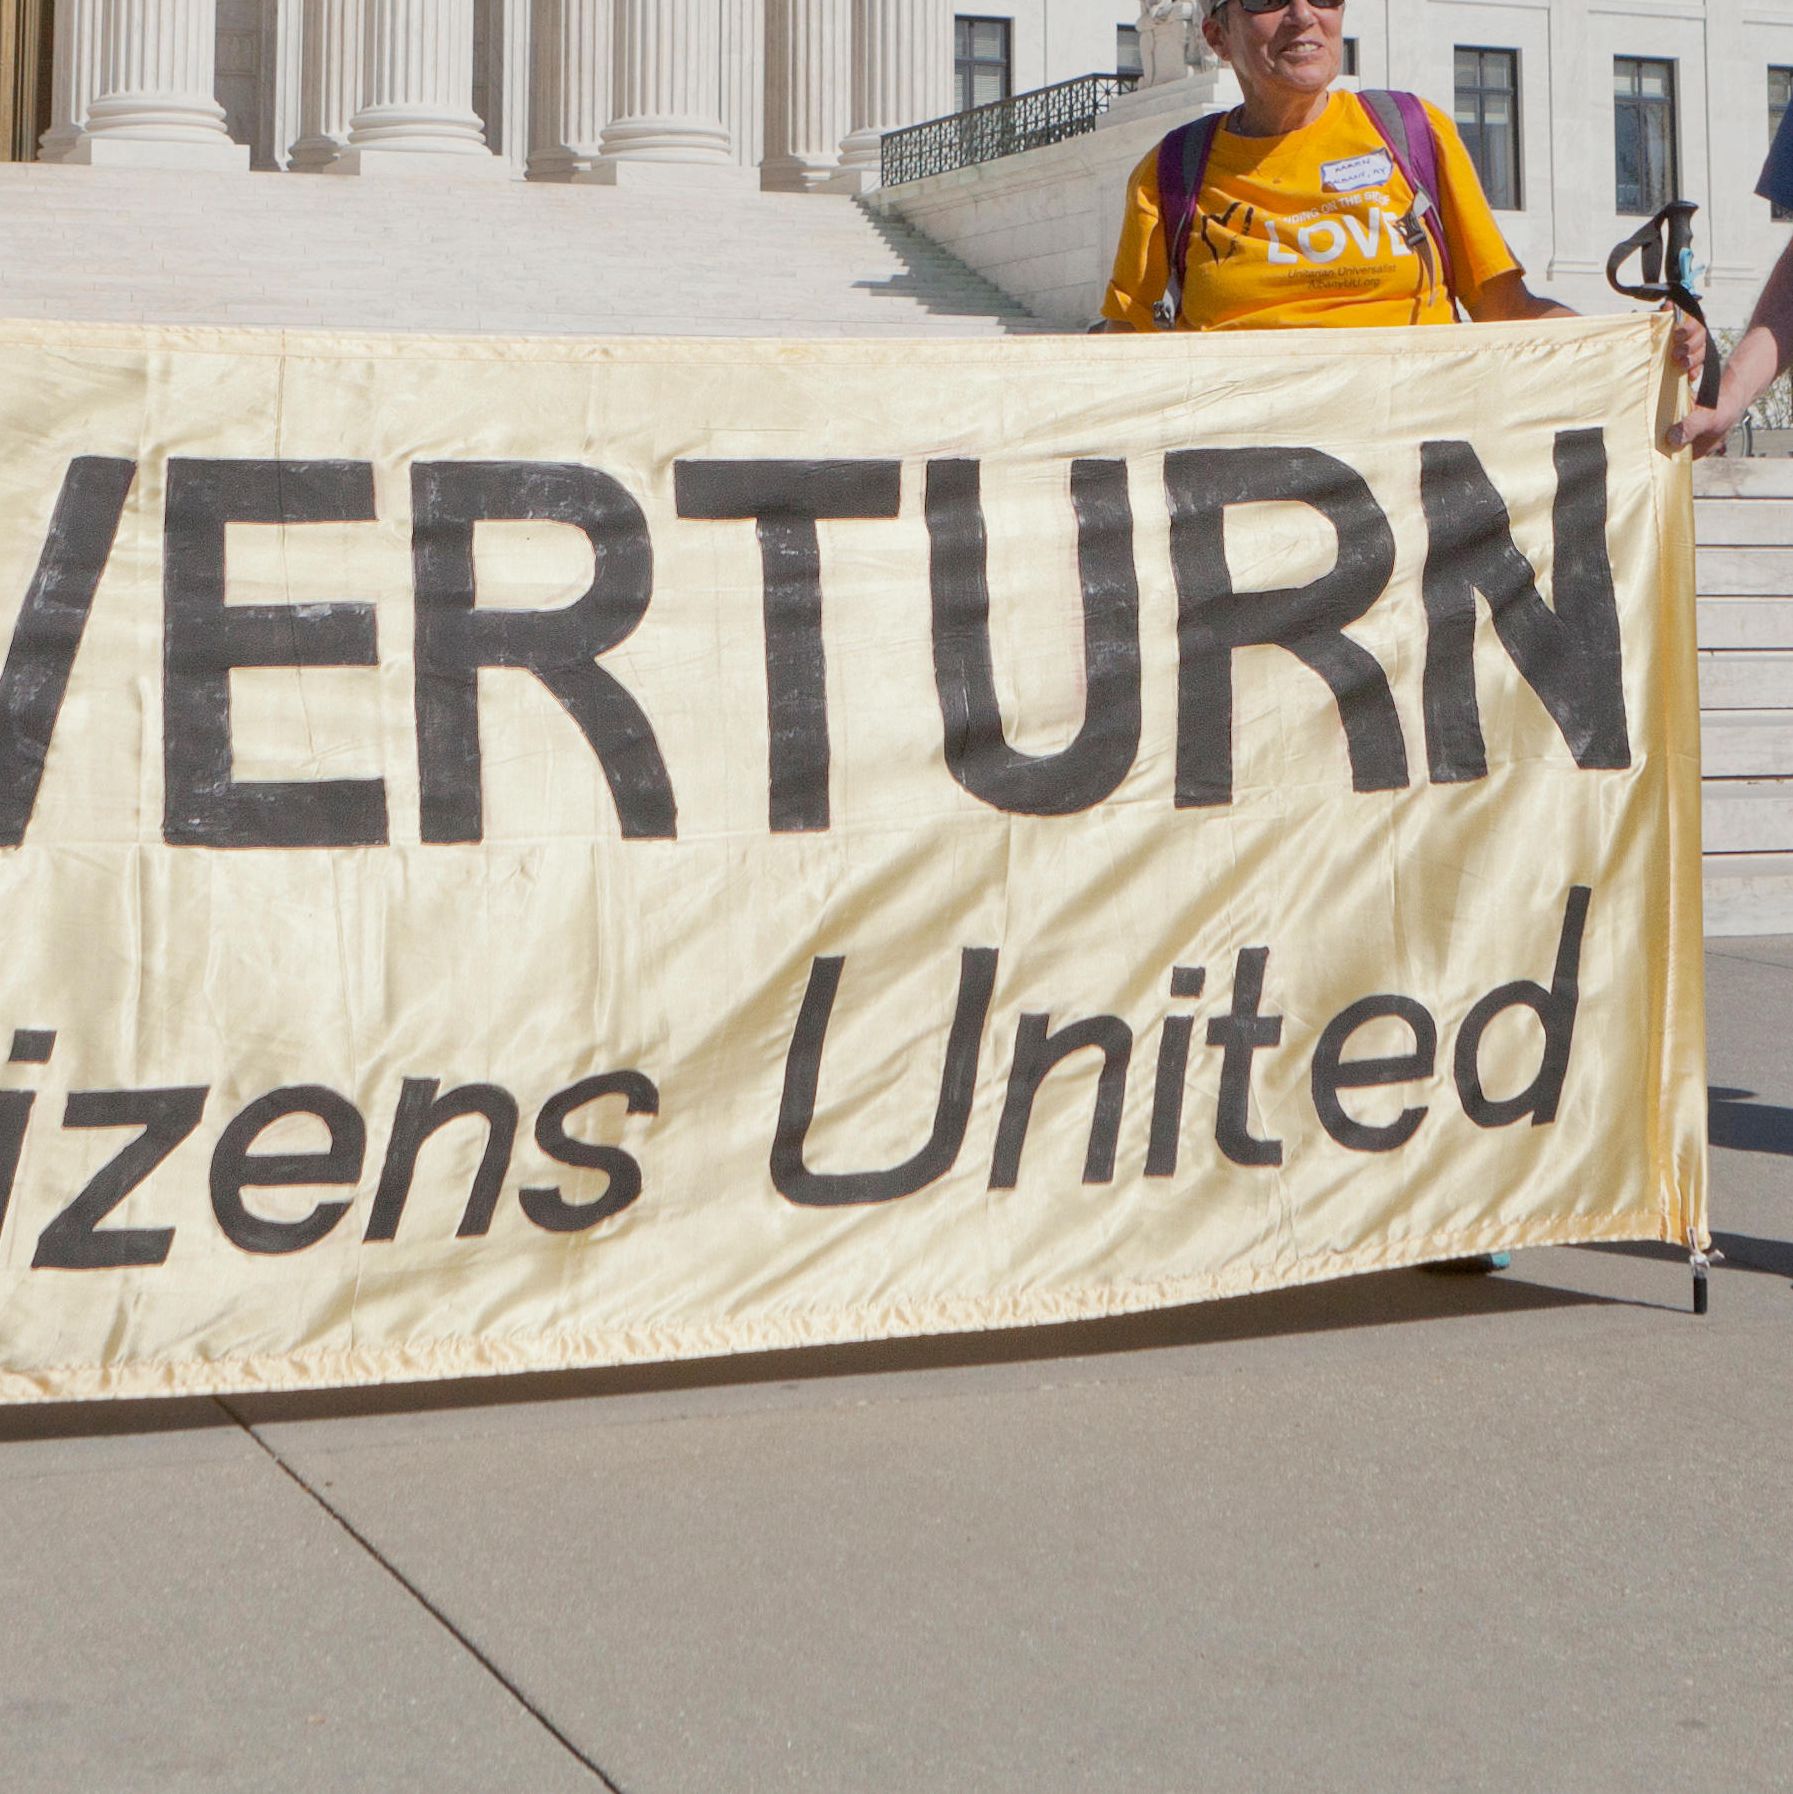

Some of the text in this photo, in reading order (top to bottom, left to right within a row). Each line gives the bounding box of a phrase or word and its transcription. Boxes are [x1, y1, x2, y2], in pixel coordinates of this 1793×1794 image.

[1321, 201, 1338, 214] ON
[1338, 194, 1363, 207] THE
[1264, 207, 1413, 263] LOVE
[1287, 268, 1335, 279] Unitarian
[769, 886, 1592, 1207] United
